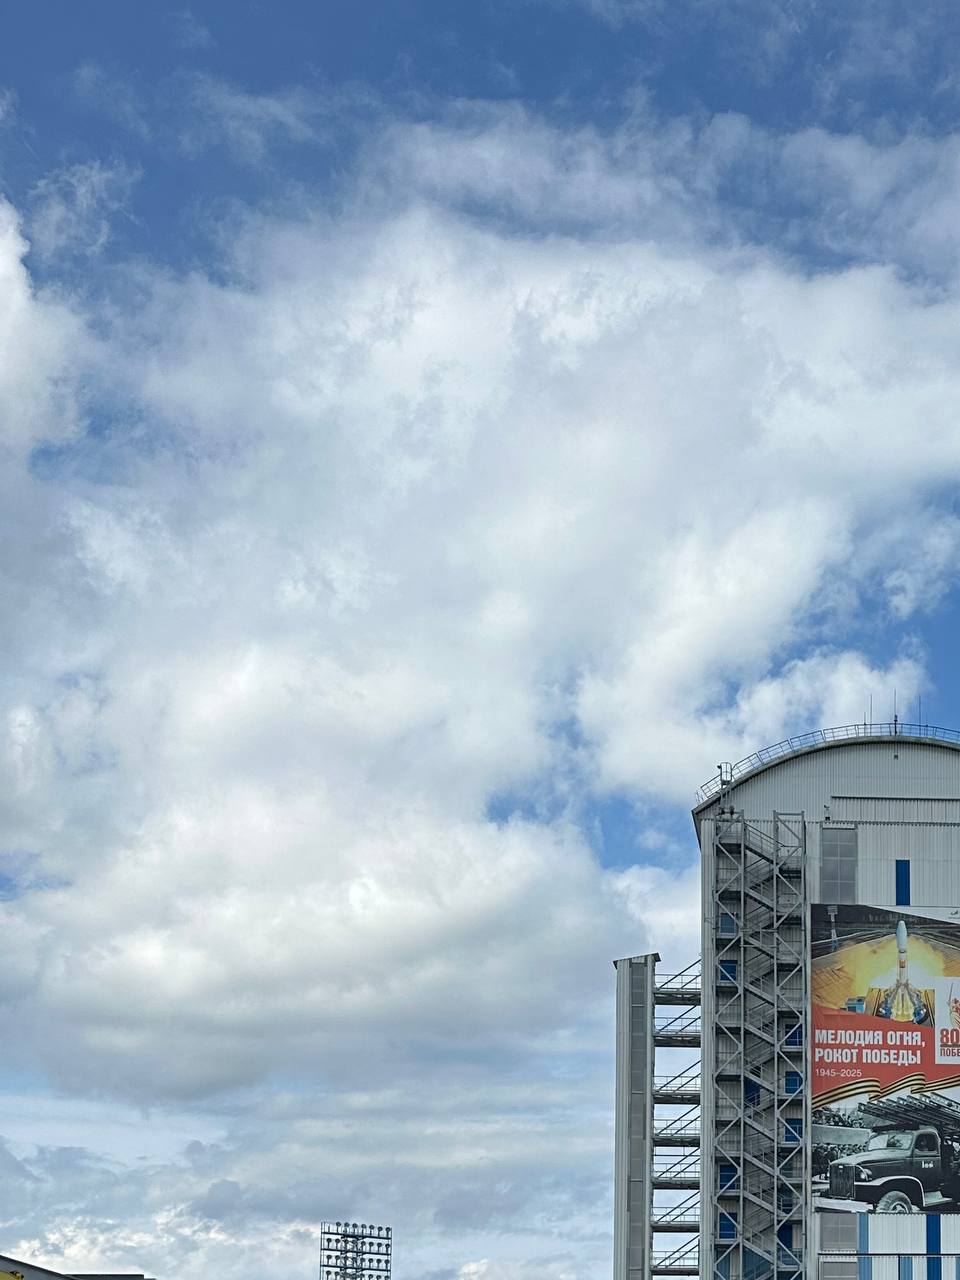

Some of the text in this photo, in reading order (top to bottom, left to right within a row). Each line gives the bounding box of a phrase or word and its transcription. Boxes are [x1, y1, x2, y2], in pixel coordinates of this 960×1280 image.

[815, 1029, 925, 1047] МЕЛОДИЯ ОГНЯ,
[940, 1028, 959, 1044] 80
[815, 1048, 921, 1066] РОКОТ ПОБЕДЫ
